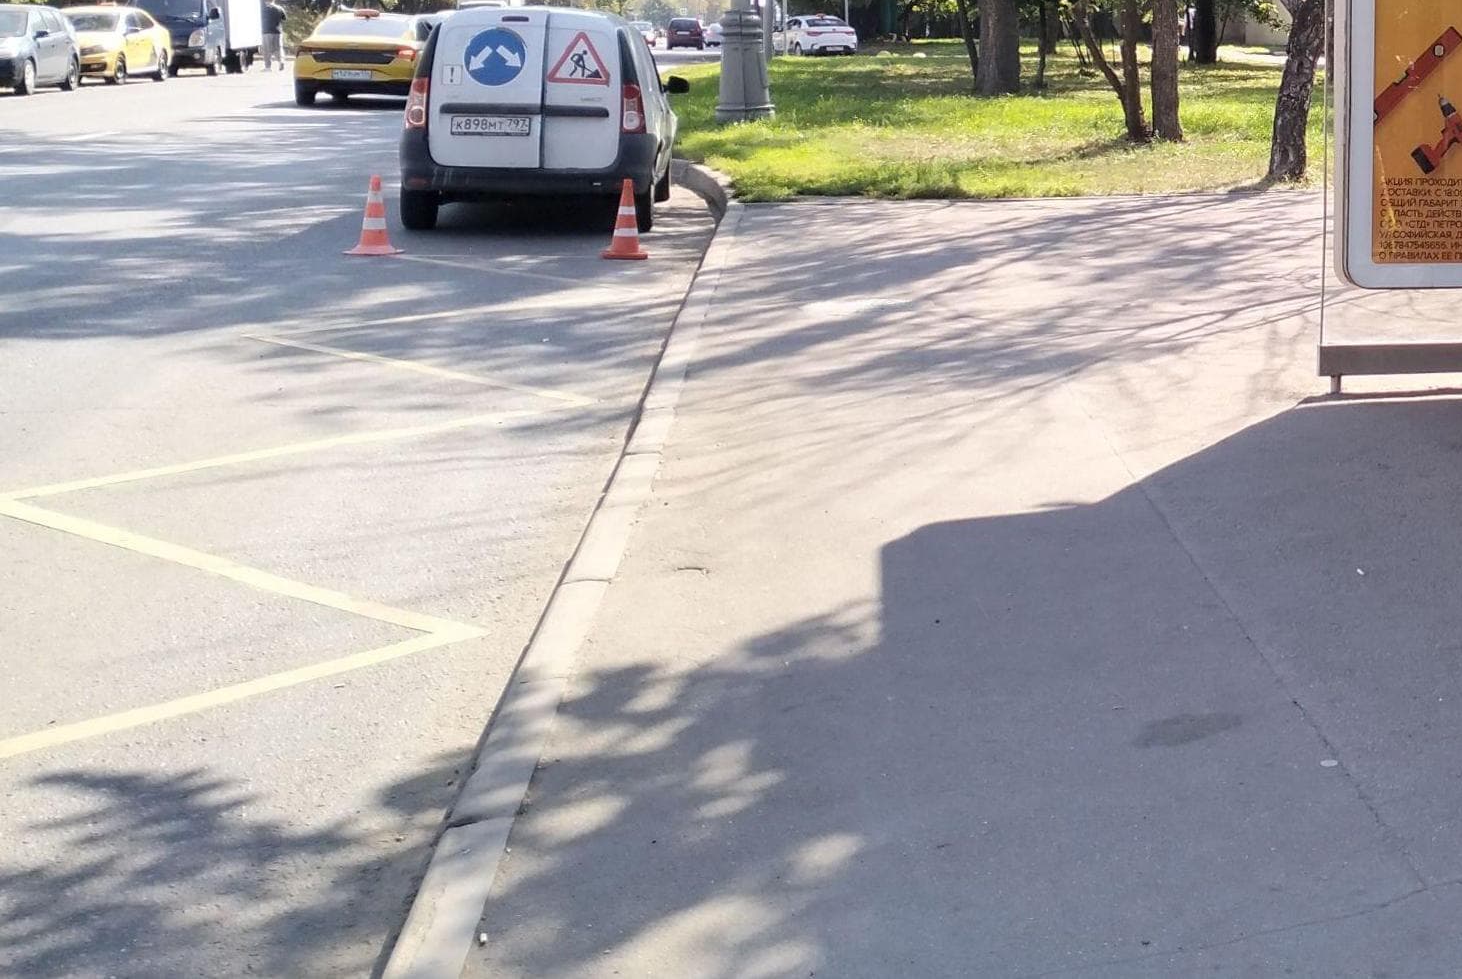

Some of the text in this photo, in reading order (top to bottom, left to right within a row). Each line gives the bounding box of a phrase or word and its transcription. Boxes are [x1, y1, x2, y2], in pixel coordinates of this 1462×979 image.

[1434, 188, 1442, 197] С
[1419, 199, 1458, 208] ГАБАРИТ
[1380, 209, 1424, 218] ОЛАСТЬ
[1379, 251, 1387, 260] О
[1389, 251, 1440, 260] ПРАВИЛАХ
